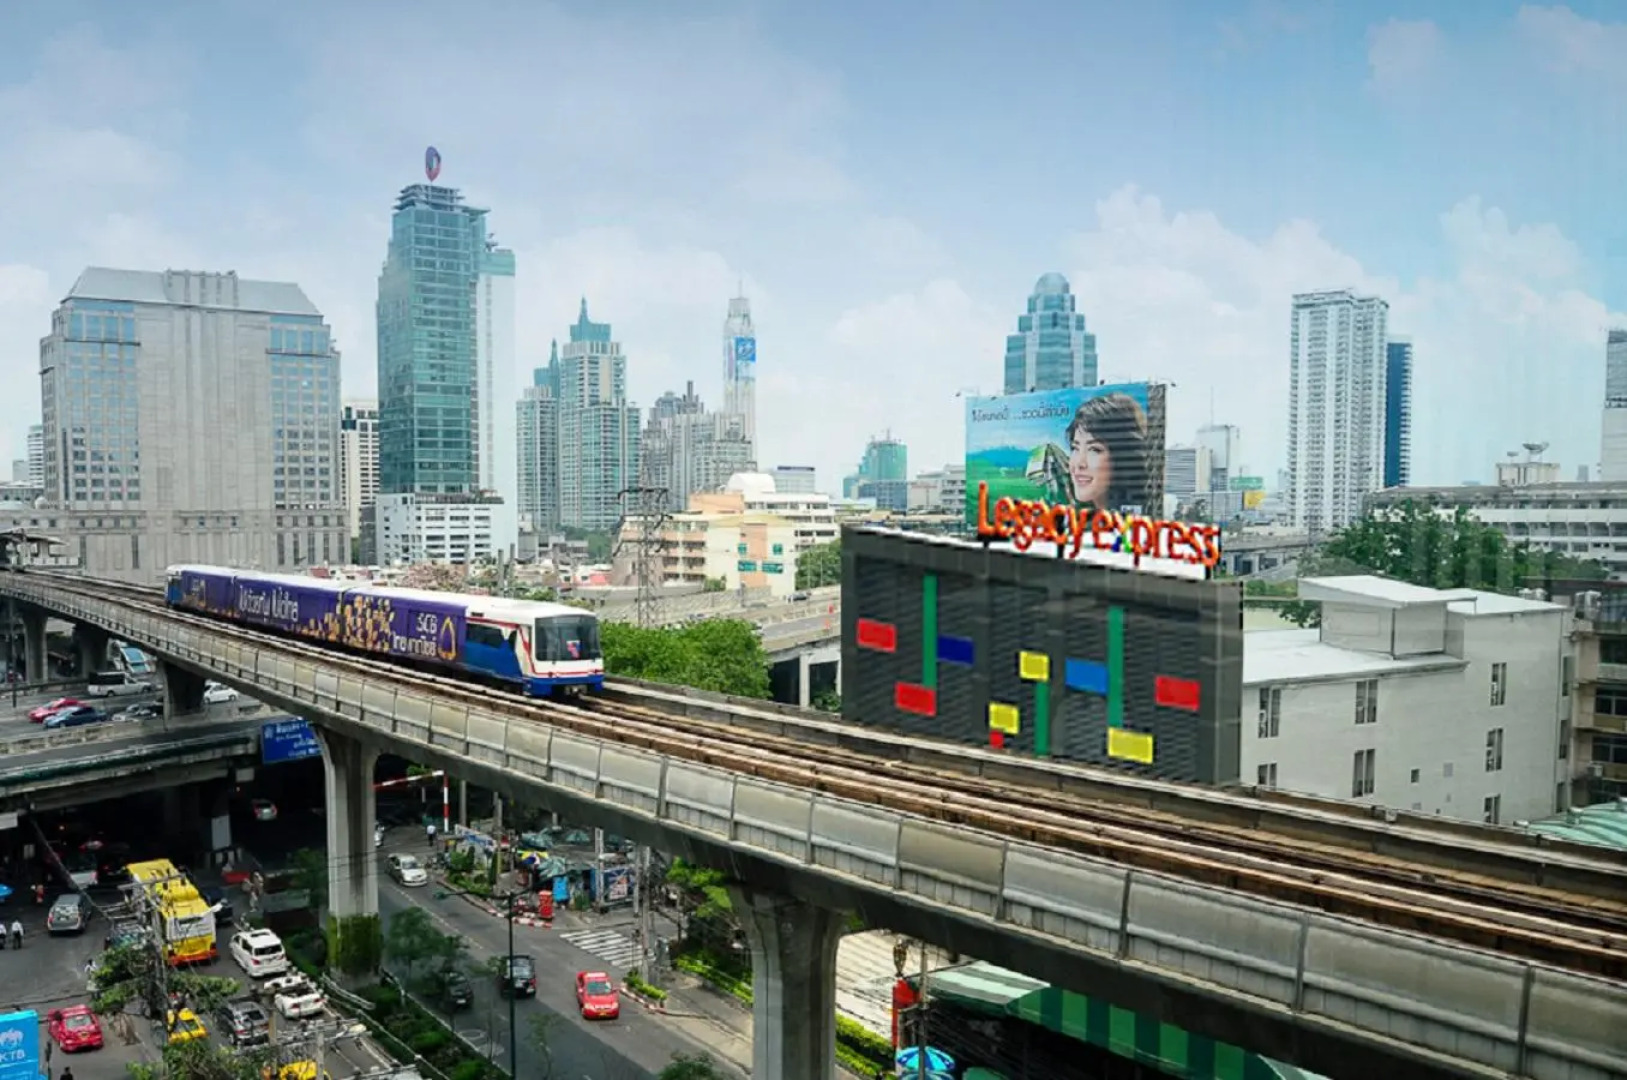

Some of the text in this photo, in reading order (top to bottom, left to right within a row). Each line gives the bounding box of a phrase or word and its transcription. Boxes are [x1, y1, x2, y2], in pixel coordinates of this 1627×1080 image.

[978, 481, 1220, 567] Legacy express
[416, 612, 438, 635] SCB
